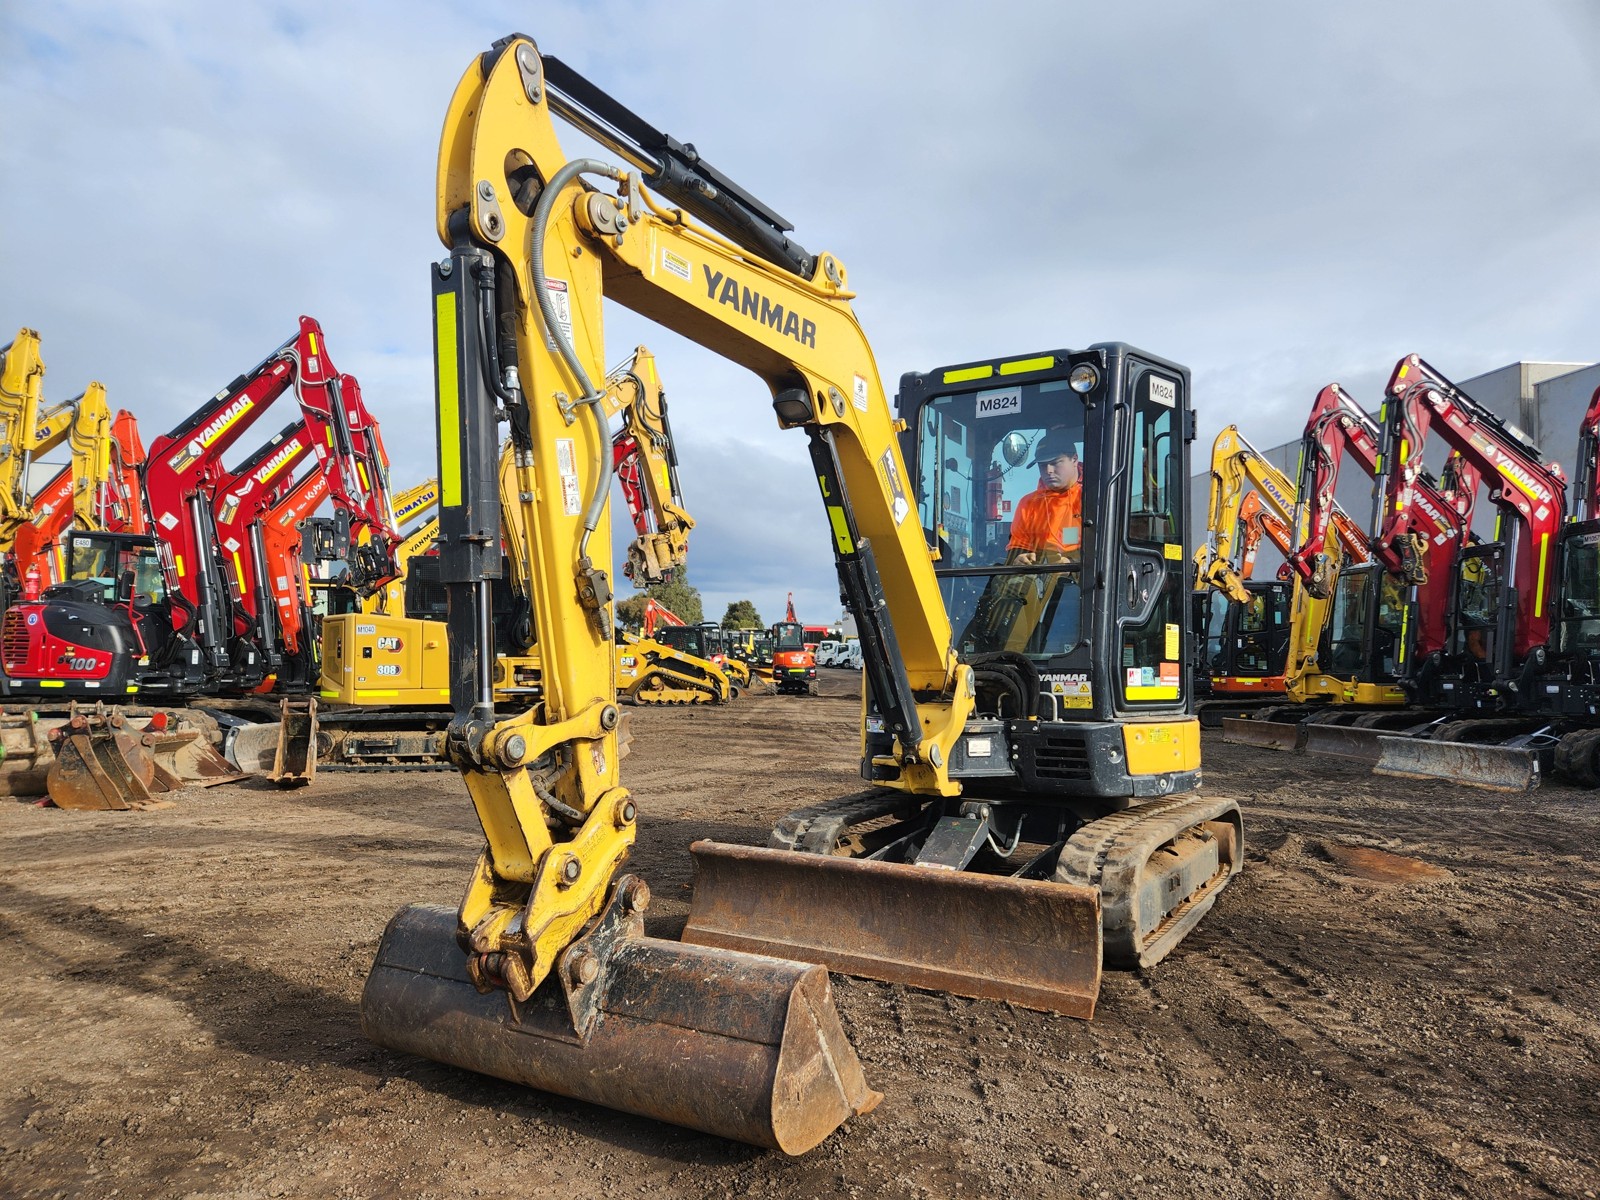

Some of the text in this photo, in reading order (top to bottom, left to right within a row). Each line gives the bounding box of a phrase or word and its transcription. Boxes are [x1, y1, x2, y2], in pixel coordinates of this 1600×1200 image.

[703, 264, 816, 349] YANMAR
[1152, 382, 1173, 400] M824
[980, 396, 1018, 411] M824
[194, 394, 252, 445] YANMAR
[253, 438, 301, 480] YANMAR
[1496, 450, 1552, 503] YANMAR
[304, 475, 326, 500] Kubo
[1263, 478, 1295, 516] KOMATS
[1277, 530, 1291, 547] HITA
[378, 637, 398, 650] CAT
[377, 665, 397, 675] 308
[1038, 673, 1088, 682] YANMAR
